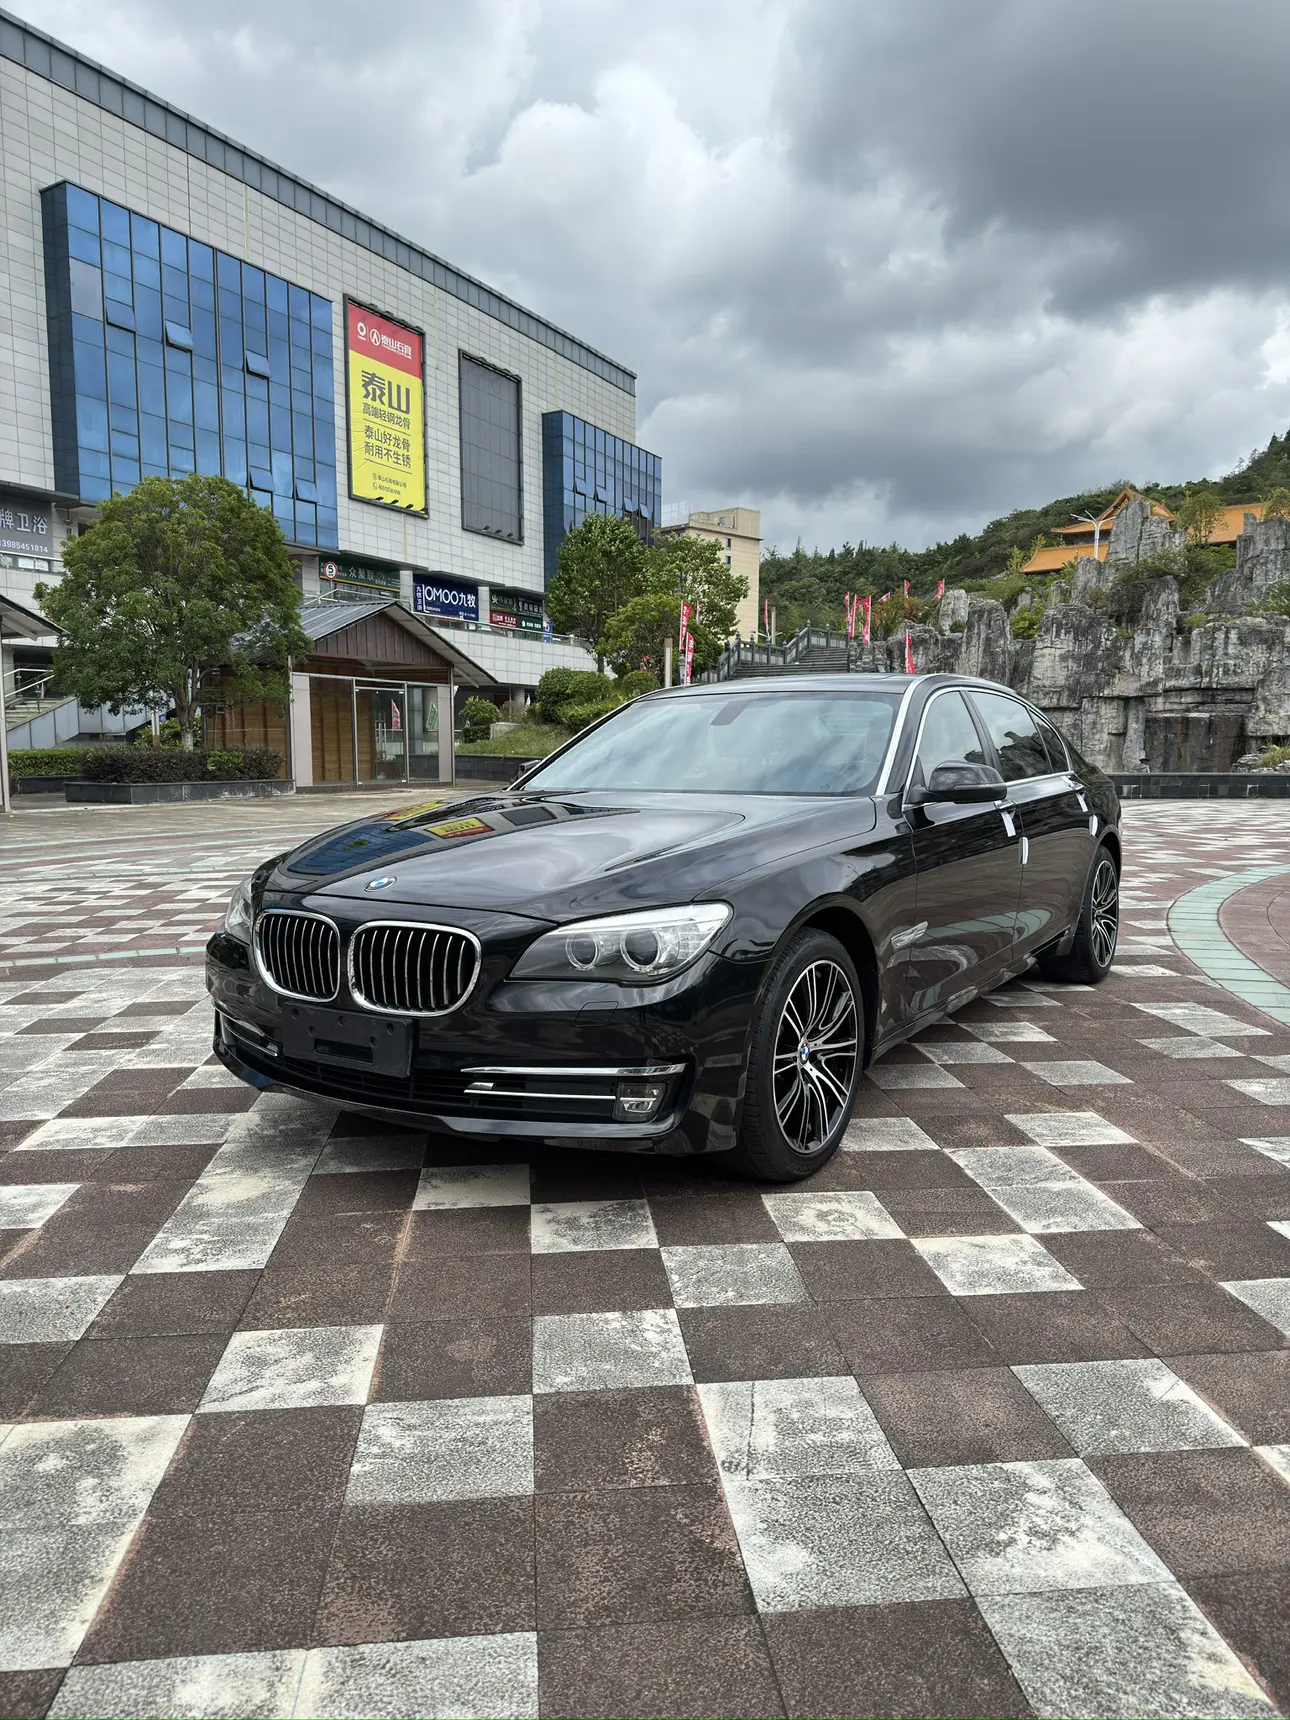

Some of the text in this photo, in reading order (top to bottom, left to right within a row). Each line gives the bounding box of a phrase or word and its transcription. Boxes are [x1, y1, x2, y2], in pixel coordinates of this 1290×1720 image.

[381, 334, 411, 356] 泰山石膏
[361, 370, 410, 415] 泰山
[362, 402, 411, 430] 高端轻钢龙骨
[364, 424, 411, 453] 泰山好龙骨
[364, 441, 411, 469] 耐用不生锈
[0, 508, 48, 534] 牌卫浴
[328, 565, 334, 573] 5
